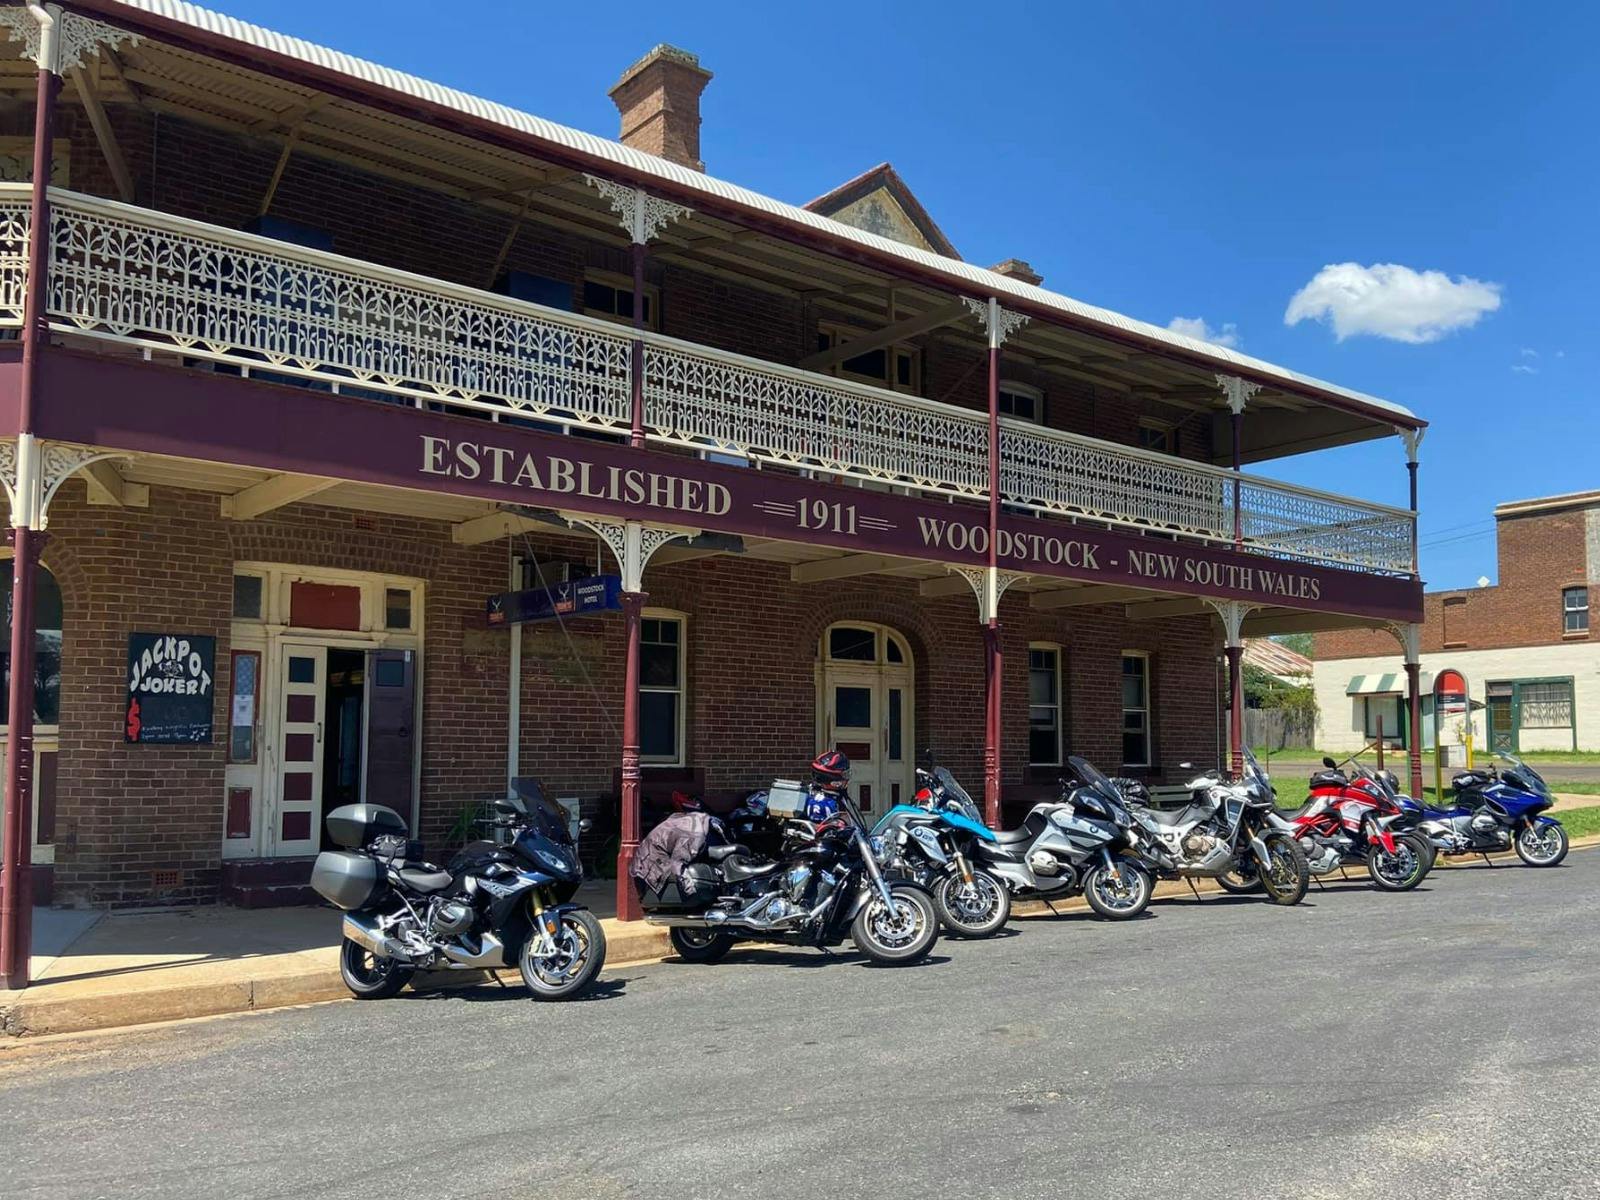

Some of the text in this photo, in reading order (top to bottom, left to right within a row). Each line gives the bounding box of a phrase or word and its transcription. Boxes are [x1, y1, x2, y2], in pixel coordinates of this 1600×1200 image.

[419, 435, 858, 535] ESTABLISHED 1911
[918, 517, 1099, 570] WOODSTOCK
[1128, 550, 1180, 579] NEW
[1184, 560, 1254, 591] SOUTH
[1258, 571, 1321, 600] WALES
[130, 636, 211, 696] JACKPOT
[140, 678, 198, 695] JOKER
